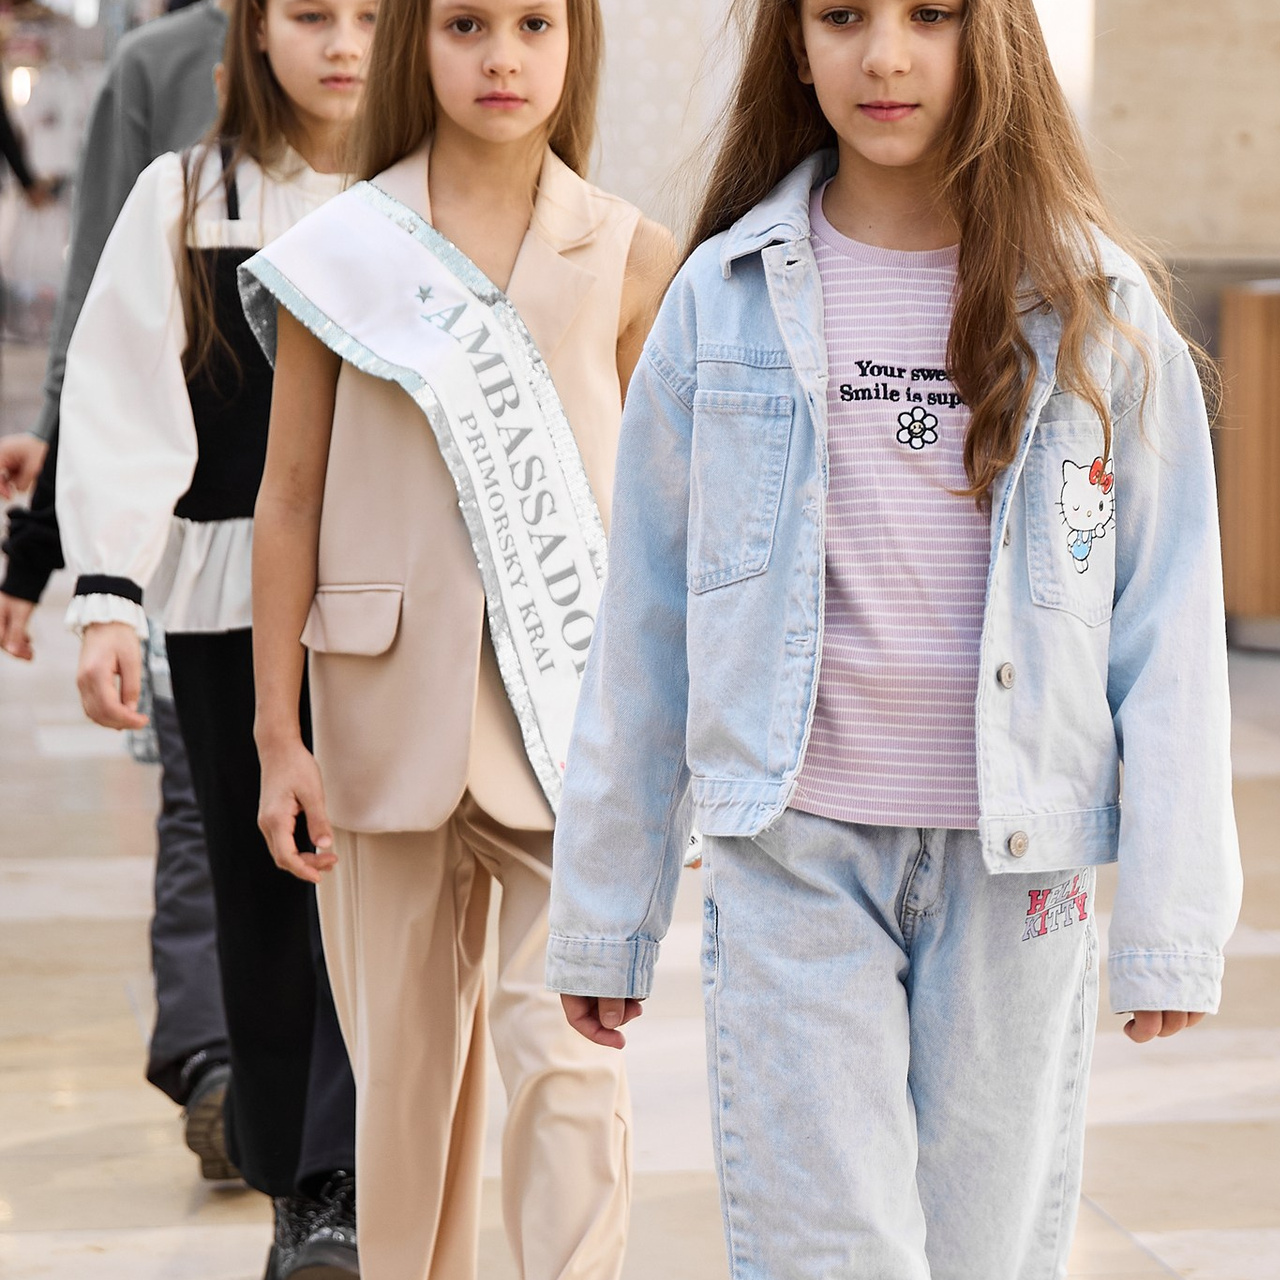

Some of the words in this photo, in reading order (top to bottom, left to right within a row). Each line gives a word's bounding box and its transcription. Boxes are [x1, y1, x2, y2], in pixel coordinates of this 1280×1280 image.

[854, 360, 906, 379] Your
[911, 368, 952, 382] swe
[840, 383, 900, 402] Smile
[906, 387, 923, 403] is
[927, 392, 967, 408] sup
[420, 302, 595, 679] AMBASSADO
[459, 410, 528, 589] PRIMORSKY
[518, 599, 555, 675] KRAI
[1027, 867, 1088, 915] HELLO
[1022, 892, 1087, 941] KITTY
